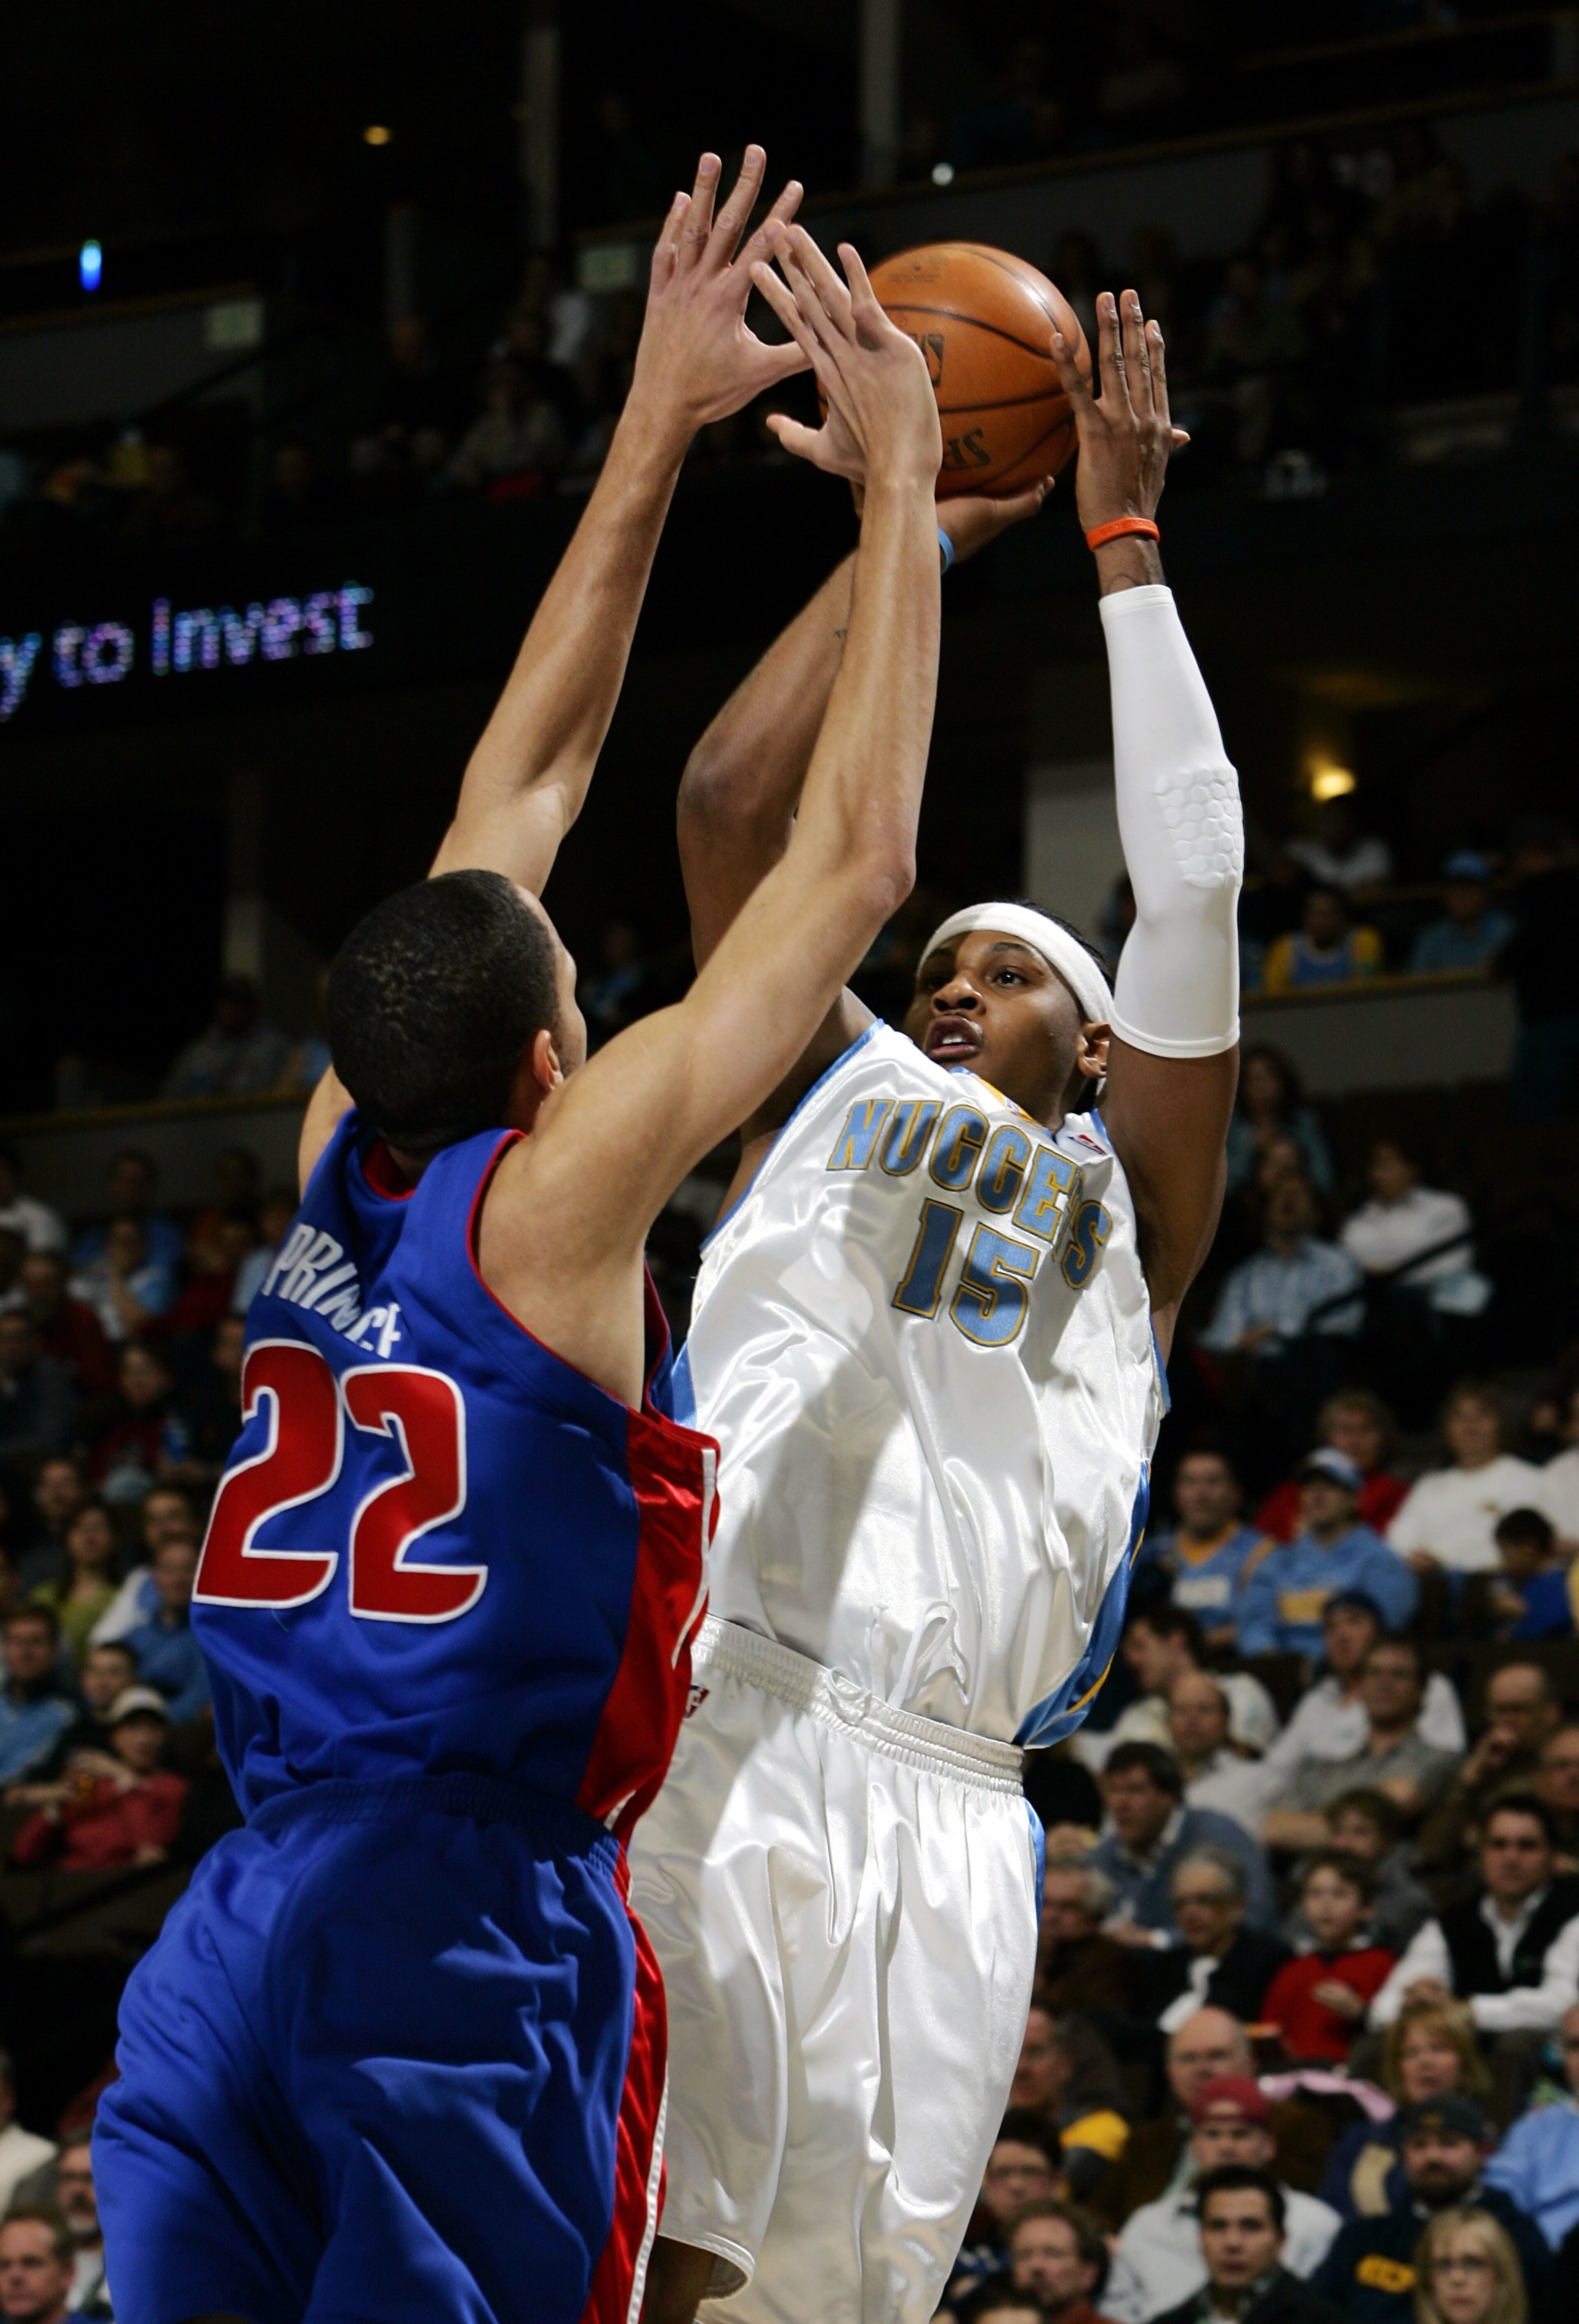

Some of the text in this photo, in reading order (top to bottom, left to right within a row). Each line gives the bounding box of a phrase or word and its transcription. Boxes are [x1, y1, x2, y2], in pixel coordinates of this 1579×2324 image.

[51, 620, 134, 688] to
[826, 1099, 1113, 1289] NUGGES
[891, 1197, 1040, 1347] 15
[192, 1338, 488, 1624] 22
